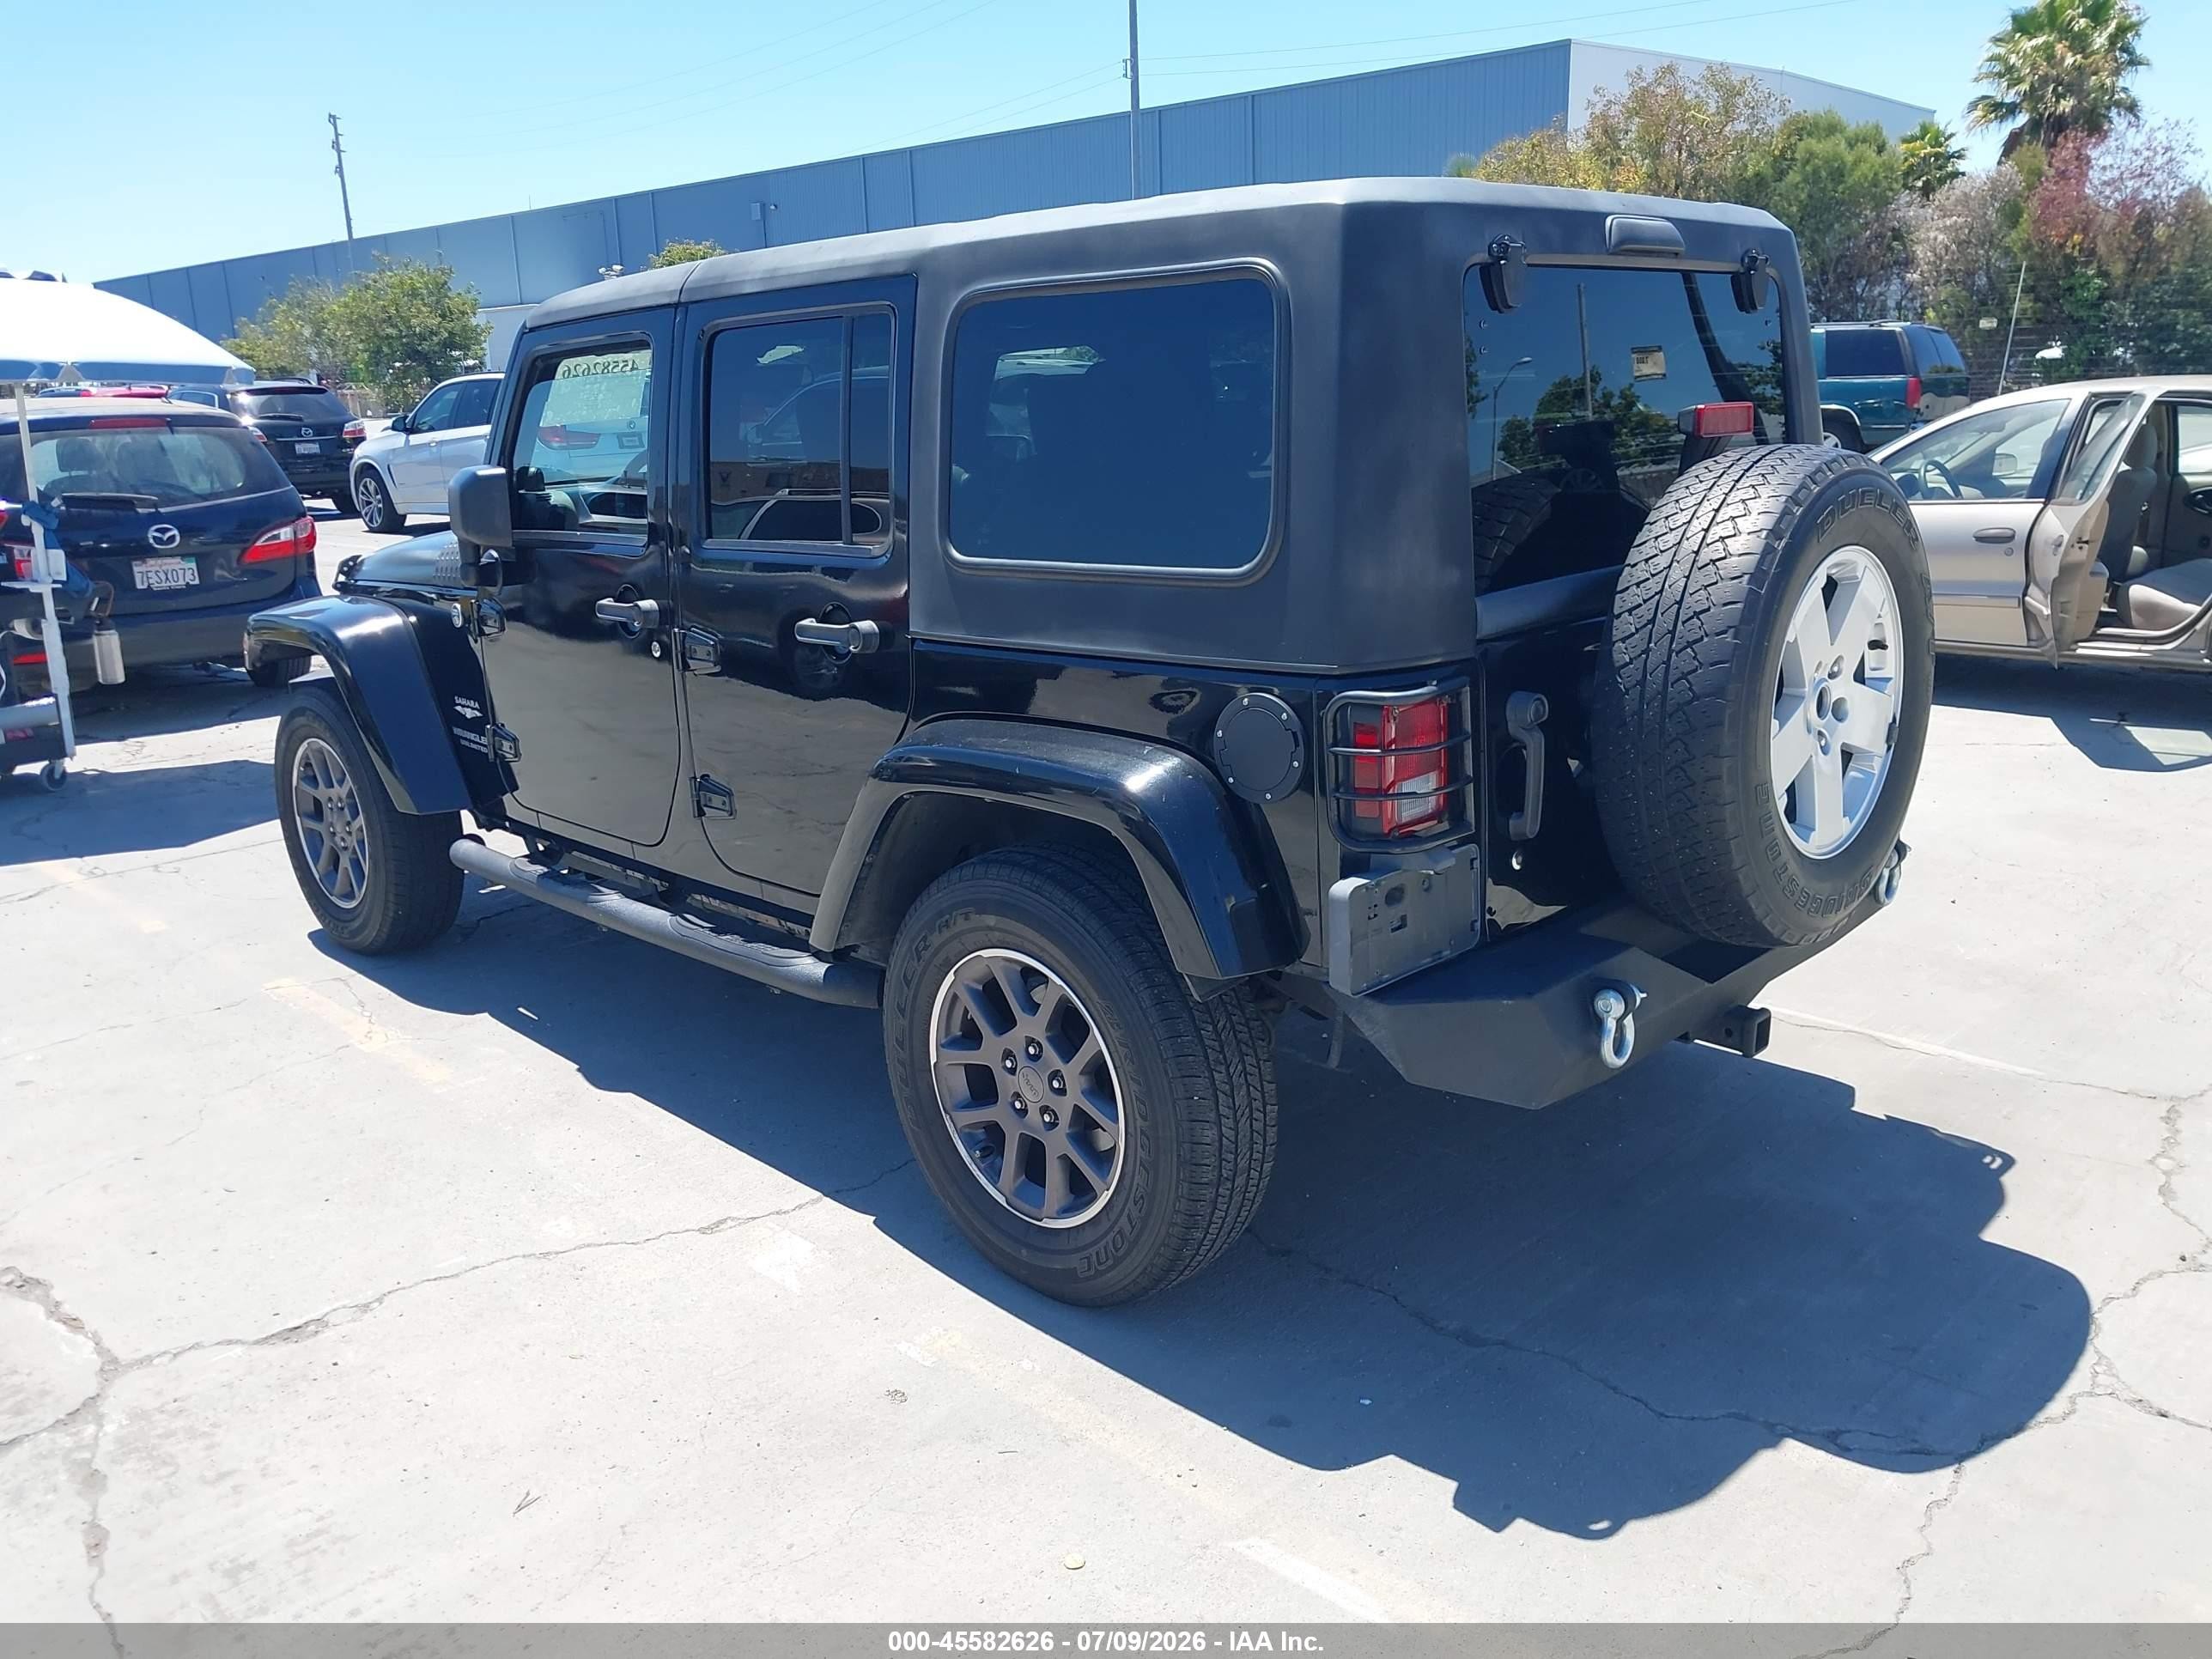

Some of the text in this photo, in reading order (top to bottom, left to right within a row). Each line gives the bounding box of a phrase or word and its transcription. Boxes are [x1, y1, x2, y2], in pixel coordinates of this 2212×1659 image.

[1816, 487, 1919, 550] DUELER
[137, 568, 198, 586] 7ESX073
[454, 696, 481, 709] SAHARA
[452, 726, 488, 745] WRANGLE
[1754, 782, 1875, 918] BRIDGESTONE
[1075, 999, 1155, 1278] BRIDGESTONE
